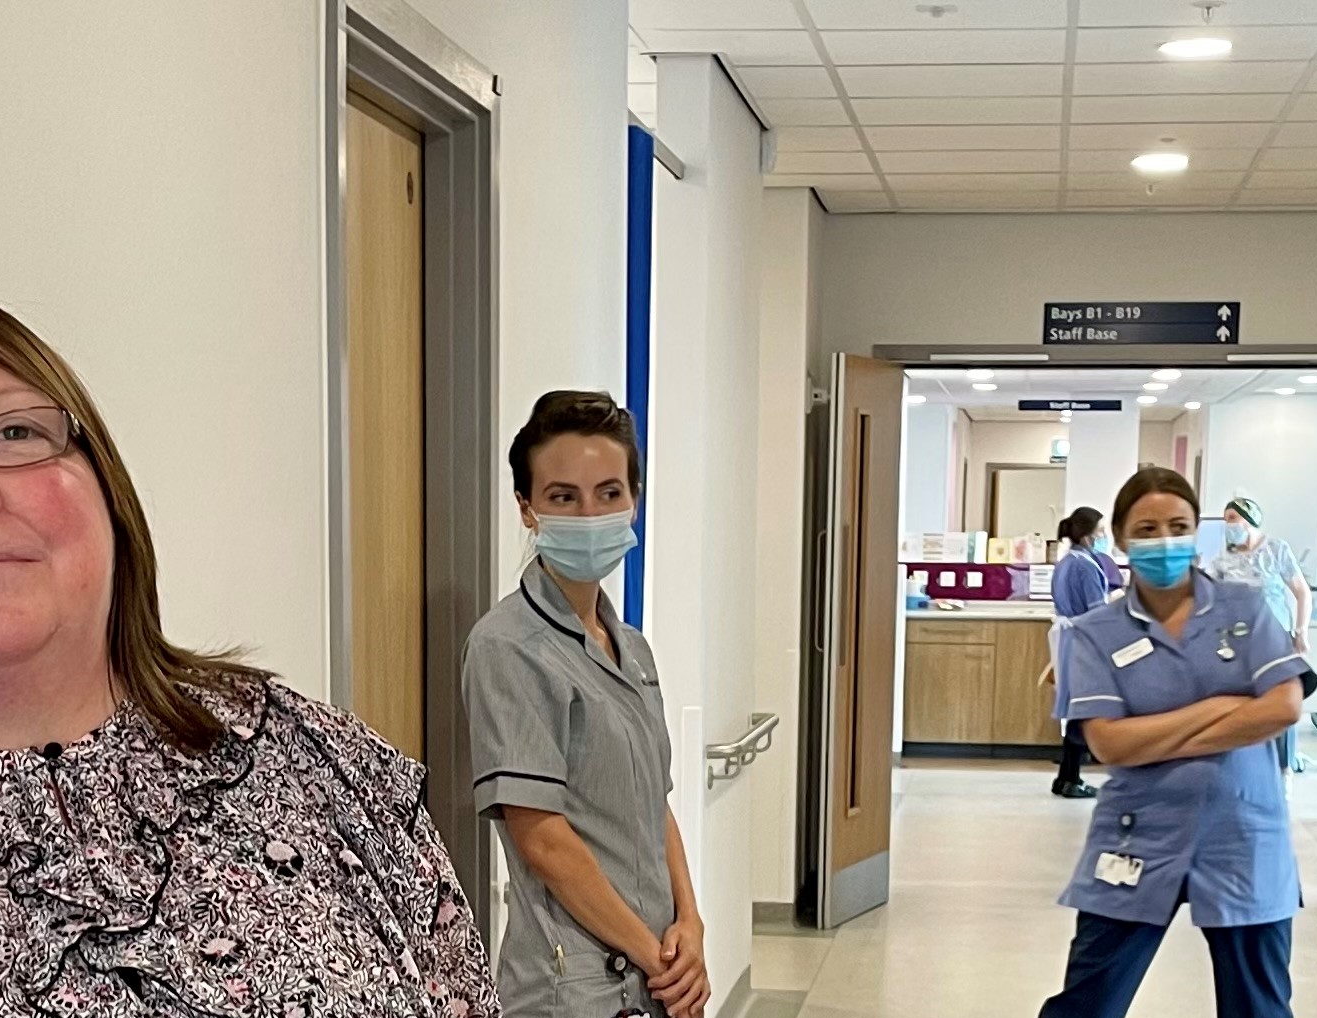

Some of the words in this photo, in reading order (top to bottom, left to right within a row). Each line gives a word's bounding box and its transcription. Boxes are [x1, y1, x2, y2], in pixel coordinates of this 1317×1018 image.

[1051, 307, 1082, 323] Bays
[1086, 306, 1102, 320] B1
[1115, 306, 1141, 320] B19
[1050, 327, 1083, 341] Staff
[1086, 327, 1118, 341] Base
